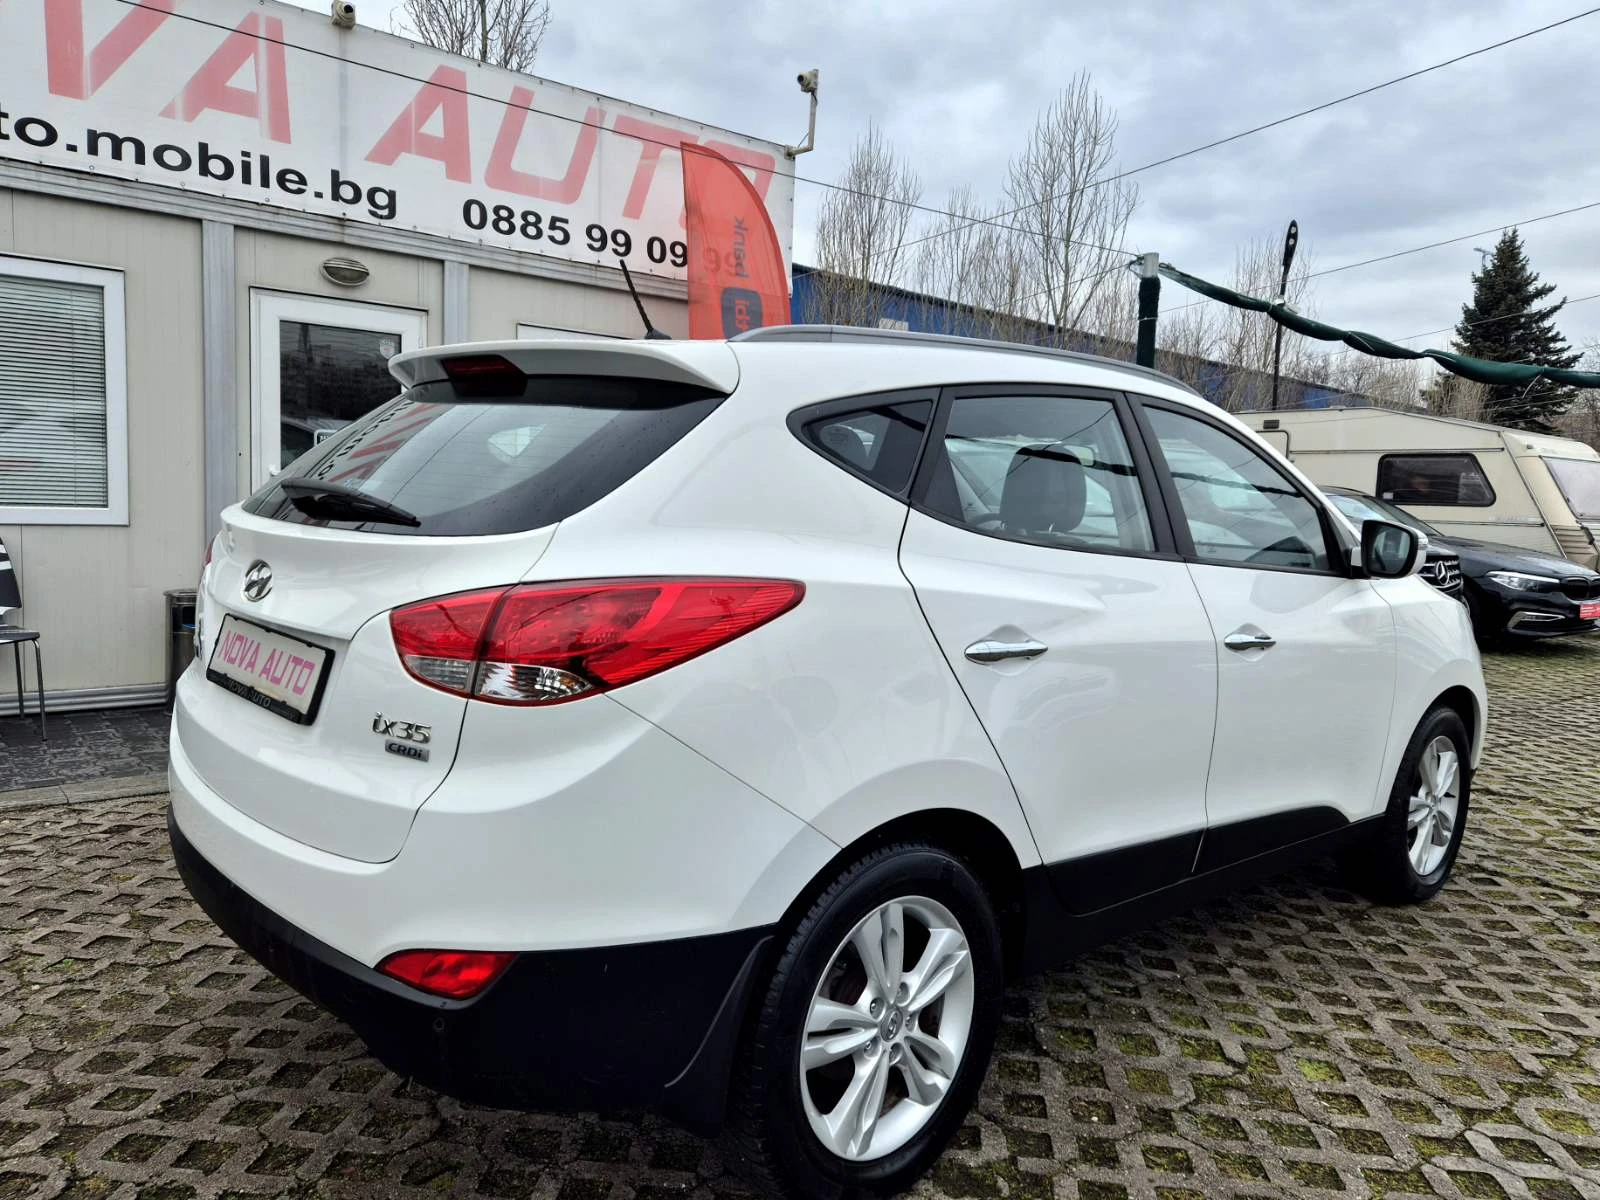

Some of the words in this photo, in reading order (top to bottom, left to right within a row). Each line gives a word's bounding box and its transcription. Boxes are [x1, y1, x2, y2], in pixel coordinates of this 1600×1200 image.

[463, 198, 571, 246] 0885
[586, 223, 632, 257] 99
[646, 236, 688, 268] 09
[218, 629, 262, 674] NOVA
[258, 648, 316, 696] AUTO
[372, 711, 432, 744] ix35
